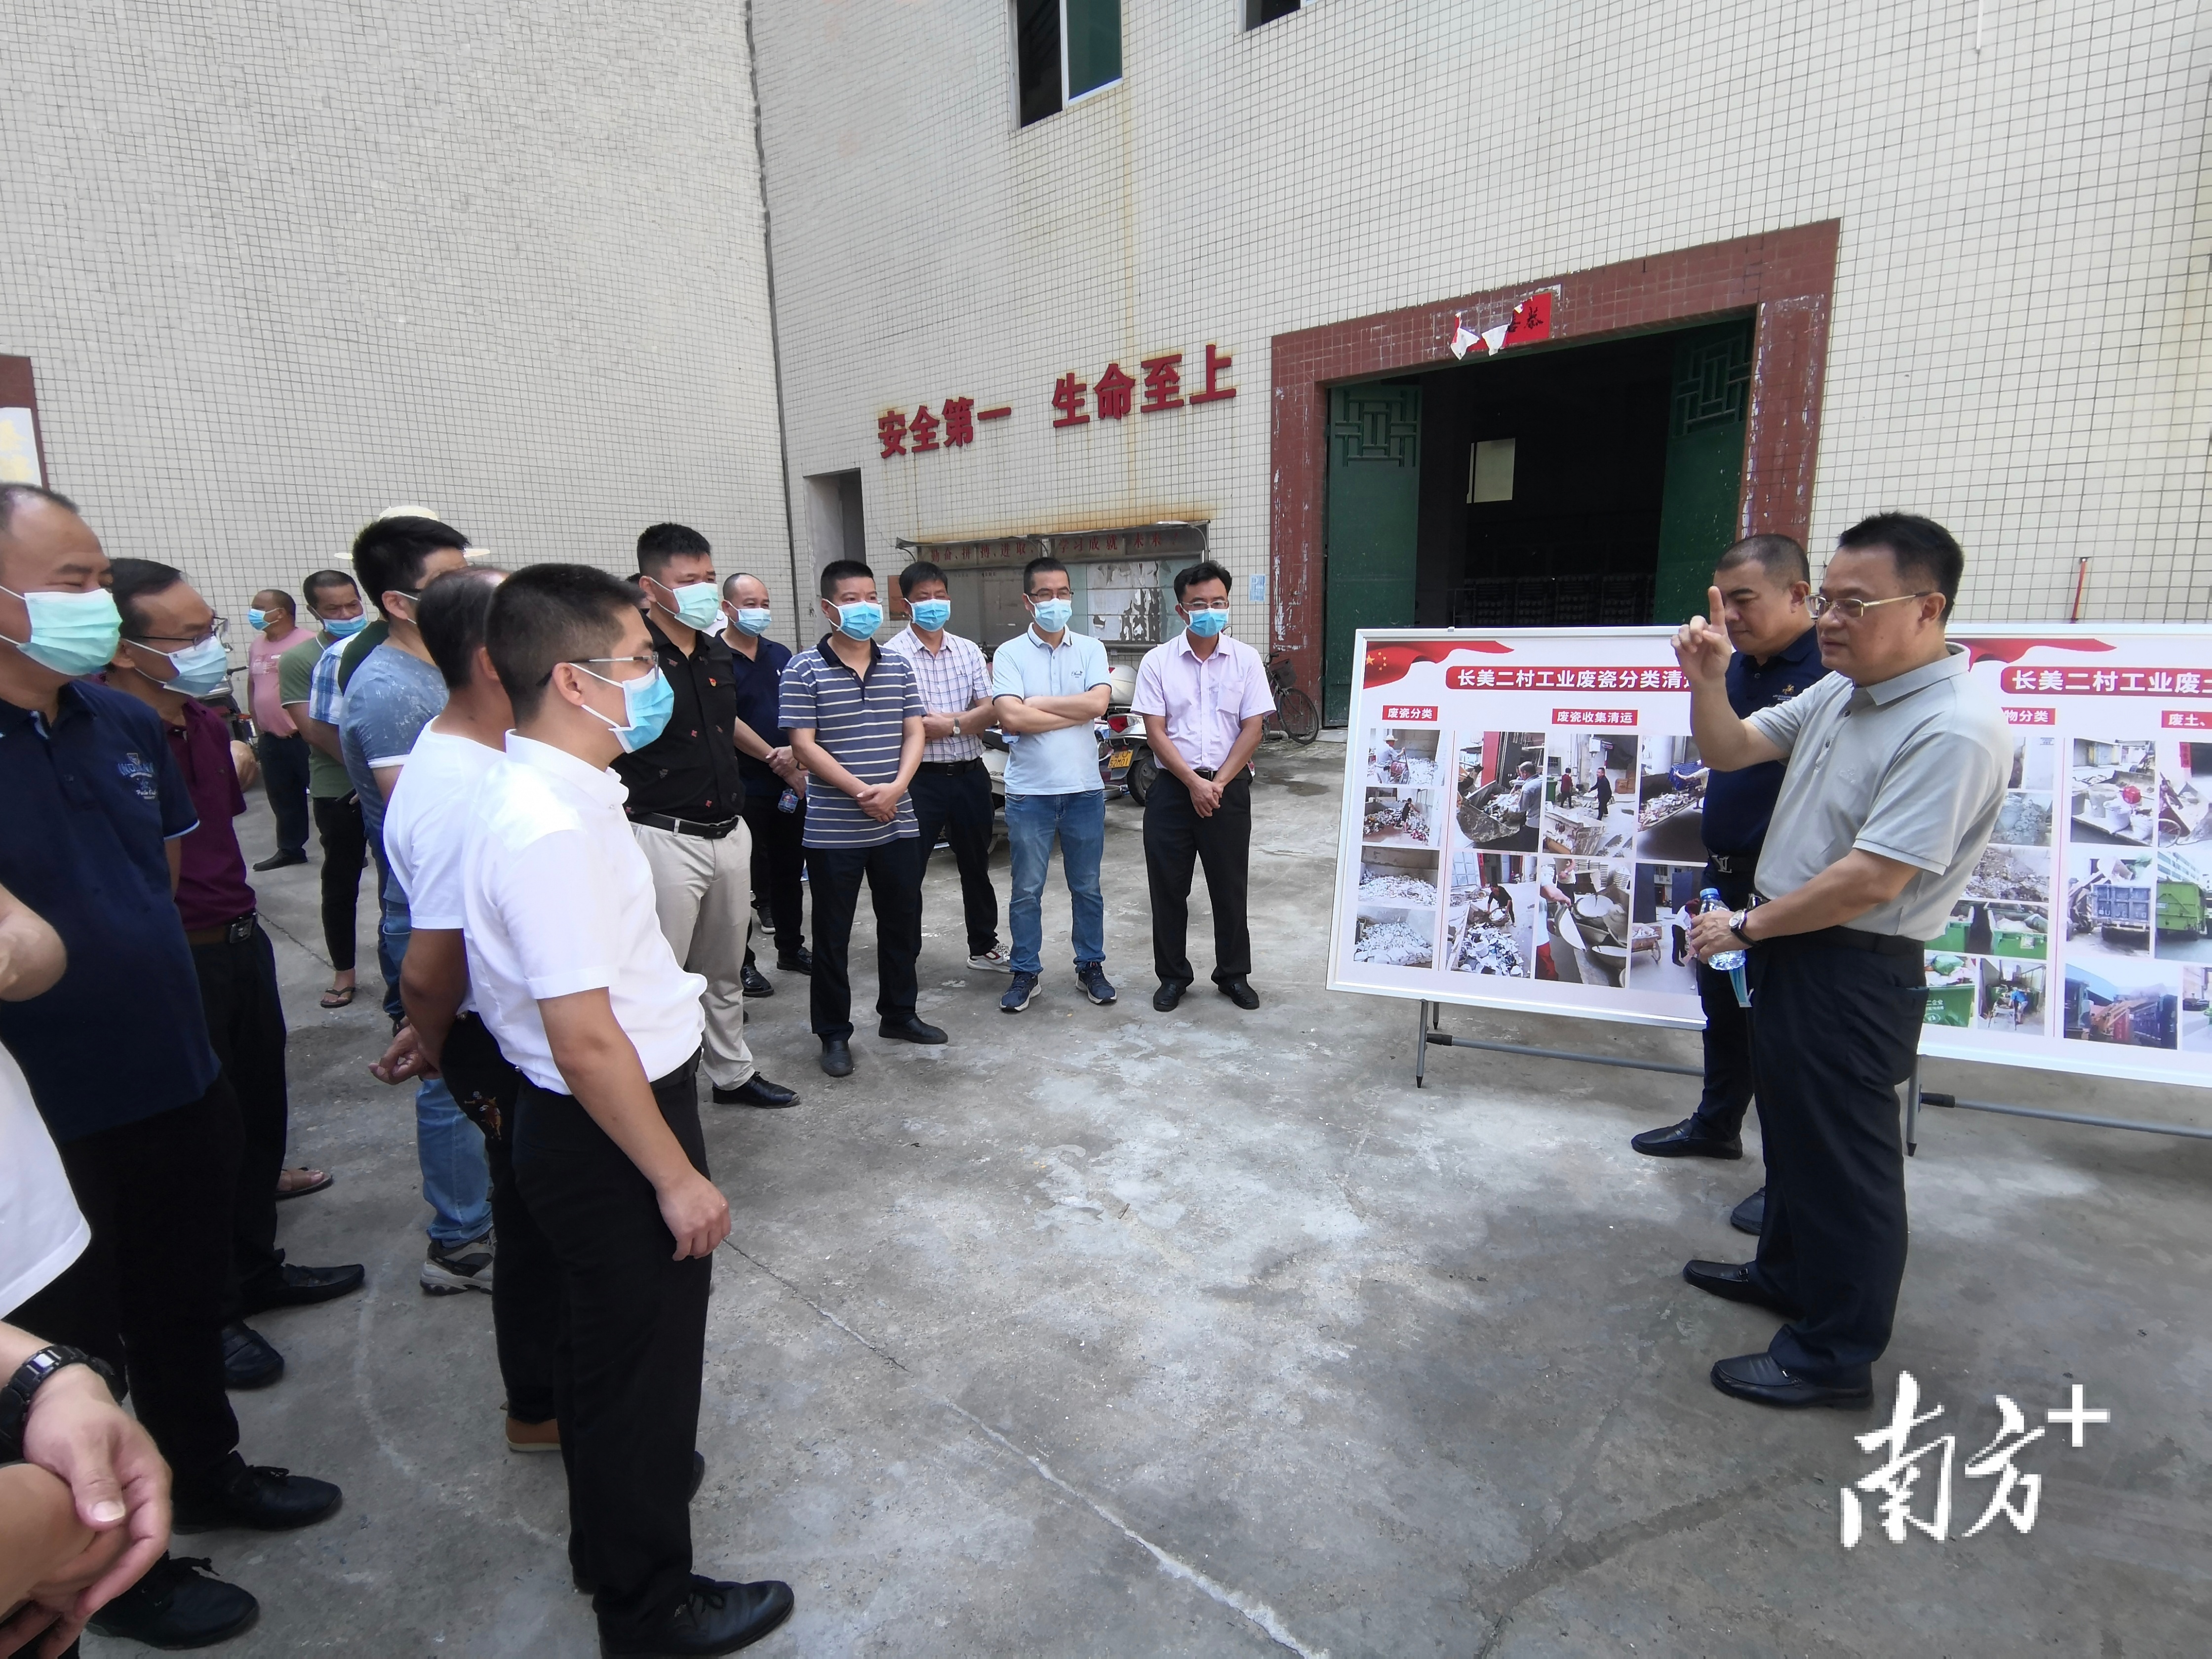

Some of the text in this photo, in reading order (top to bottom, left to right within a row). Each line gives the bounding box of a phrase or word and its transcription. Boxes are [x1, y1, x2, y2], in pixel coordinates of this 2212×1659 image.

[877, 344, 1237, 459] 安全第一 生命至上
[1387, 708, 1433, 719] 废瓷分类
[1556, 711, 1633, 723] 废瓷收集清运
